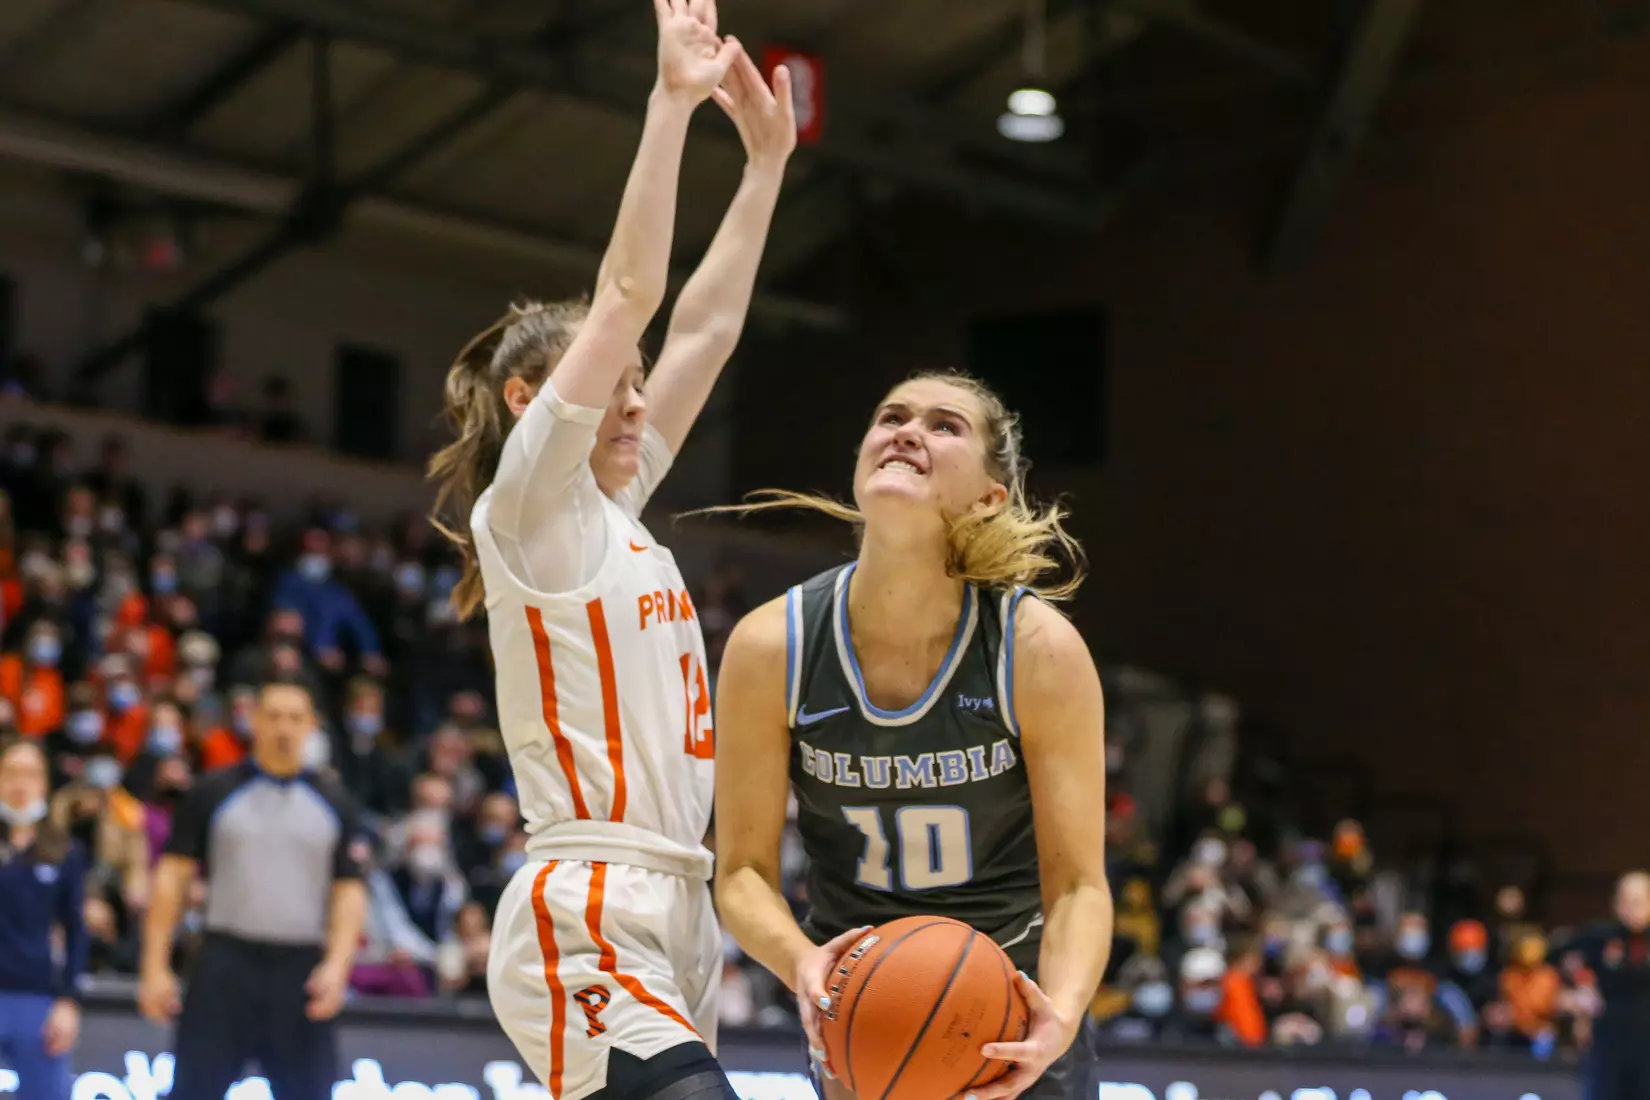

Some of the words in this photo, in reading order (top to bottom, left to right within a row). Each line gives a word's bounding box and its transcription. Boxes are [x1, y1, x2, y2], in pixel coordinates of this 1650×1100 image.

[958, 693, 982, 711] Ivy
[799, 738, 1017, 790] COLUMBIA
[840, 804, 974, 893] 10
[572, 984, 612, 1040] P
